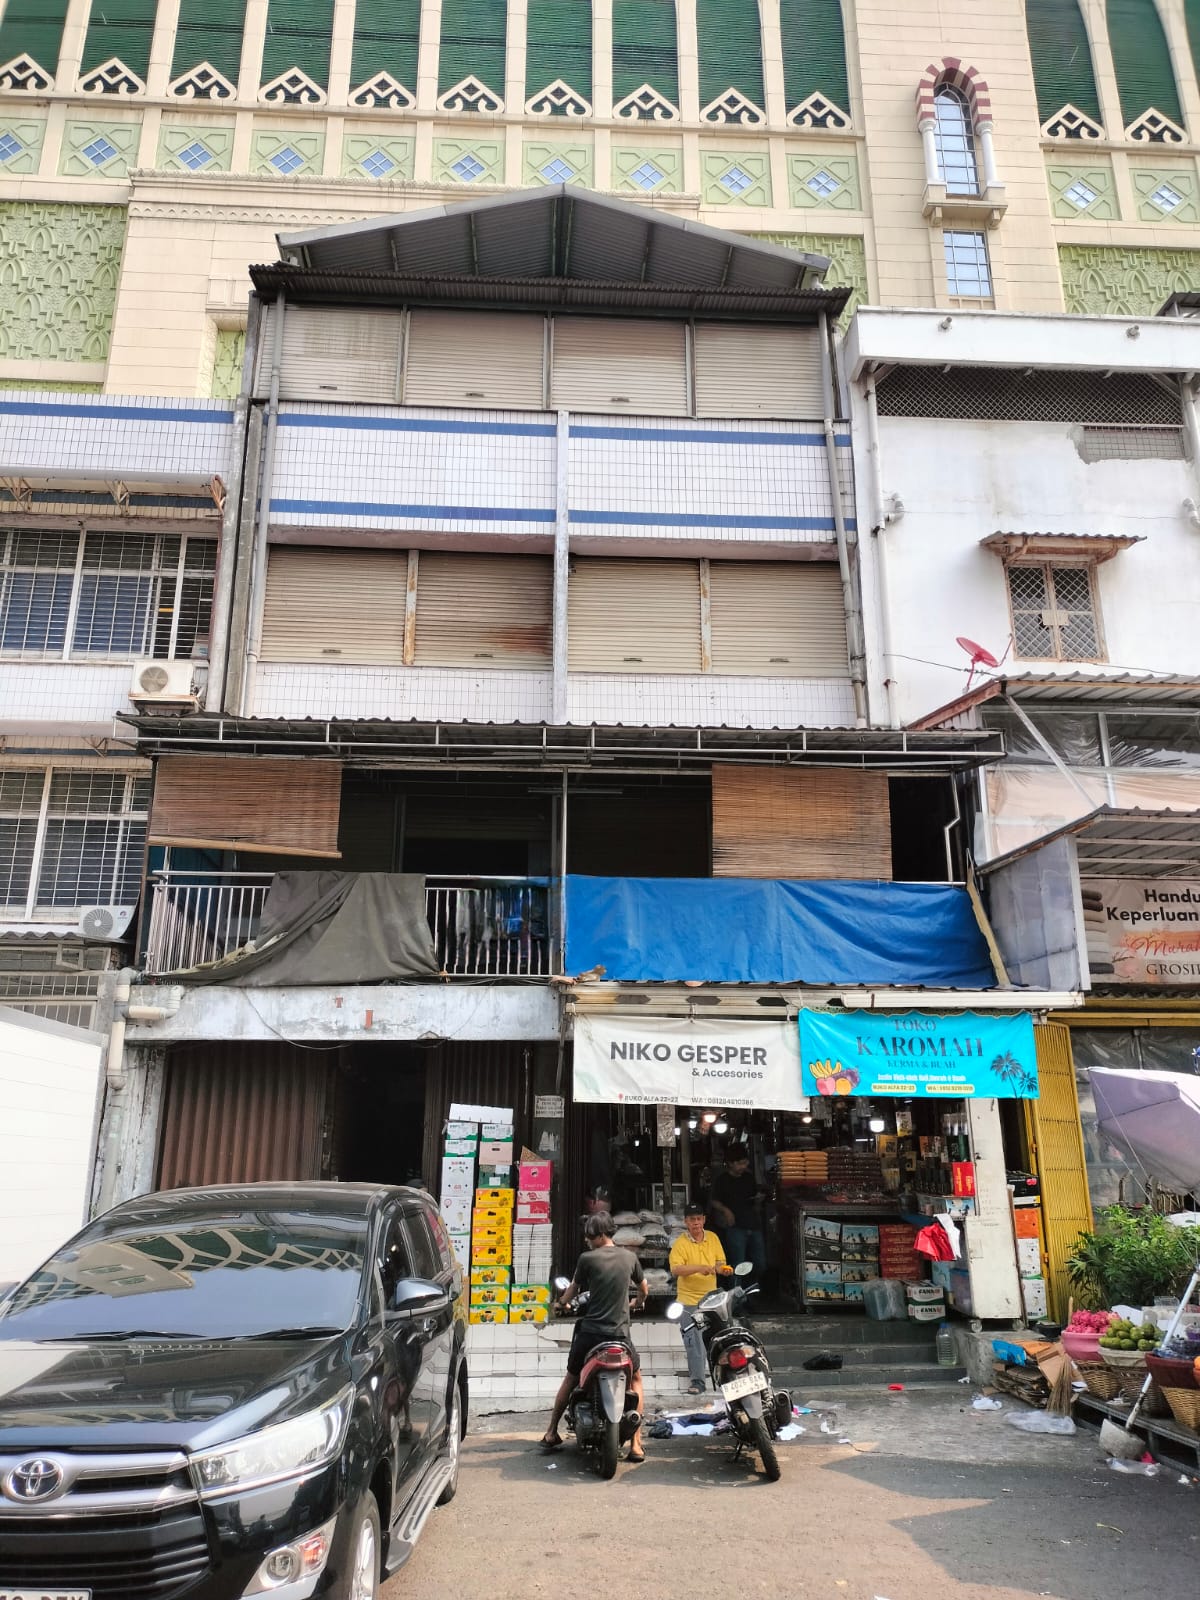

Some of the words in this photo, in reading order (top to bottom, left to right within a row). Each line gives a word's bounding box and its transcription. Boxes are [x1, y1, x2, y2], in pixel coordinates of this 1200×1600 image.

[1106, 907, 1199, 925] Keperluan
[892, 1018, 937, 1032] TOKO
[610, 1041, 671, 1062] NIKO
[677, 1044, 767, 1066] GESPER
[856, 1036, 983, 1056] KAROMAH
[691, 1067, 700, 1077] &
[702, 1068, 763, 1080] Accesories
